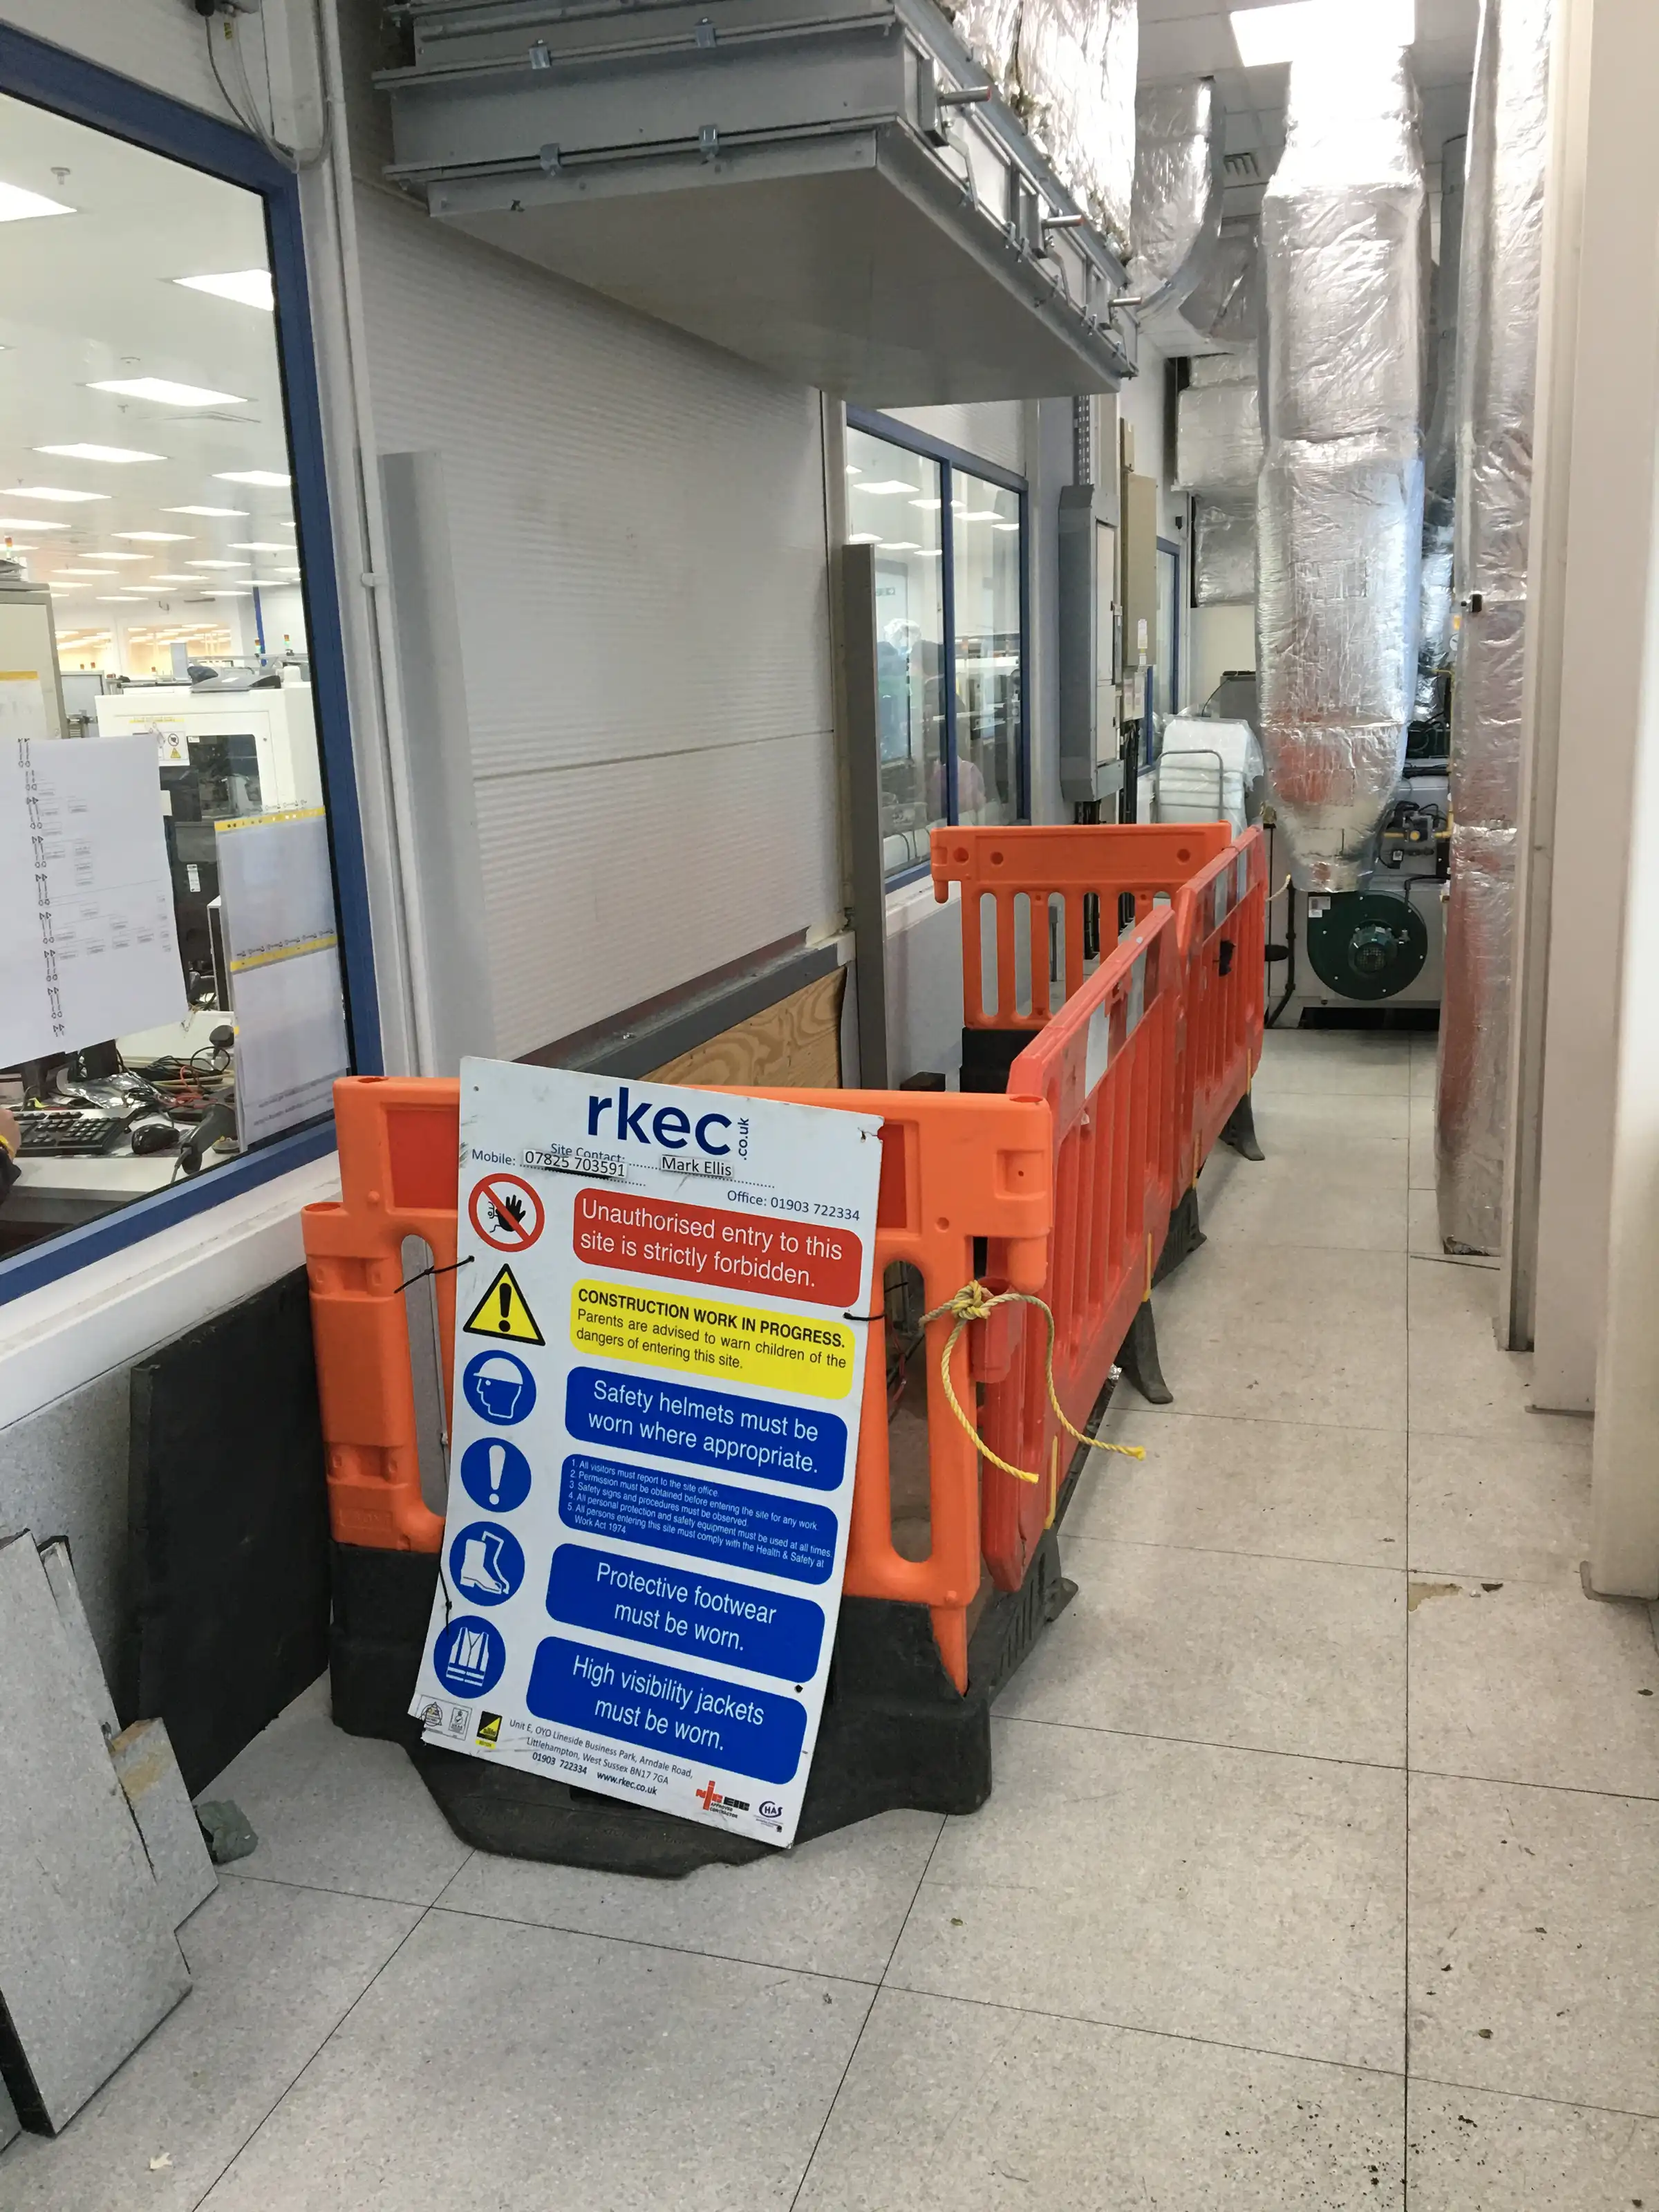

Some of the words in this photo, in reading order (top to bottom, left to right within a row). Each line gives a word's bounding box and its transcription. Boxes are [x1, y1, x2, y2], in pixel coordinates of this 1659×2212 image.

[588, 1086, 732, 1156] rkec
[737, 1117, 749, 1161] .co.uk
[472, 1148, 516, 1166] Mobile:
[525, 1150, 570, 1168] 07825
[574, 1156, 625, 1177] 703591
[551, 1143, 573, 1156] Site
[662, 1156, 700, 1173] Mark
[704, 1161, 732, 1176] Ellis
[582, 1197, 715, 1239] Unauthorised
[721, 1226, 774, 1253] entry
[779, 1231, 798, 1253] to
[805, 1235, 842, 1260] this
[727, 1190, 767, 1206] Office:
[770, 1197, 809, 1212] 01903
[813, 1203, 860, 1221] 722334
[580, 1230, 615, 1253] site
[621, 1235, 637, 1257] is
[643, 1241, 707, 1273] strictly
[713, 1250, 814, 1287] forbidden.
[577, 1307, 624, 1328] Parents
[628, 1320, 648, 1332] are
[652, 1324, 700, 1341] advised
[704, 1331, 715, 1344] to
[720, 1336, 750, 1351] warn
[755, 1340, 805, 1360] children
[809, 1351, 822, 1364] of
[826, 1353, 846, 1368] the
[578, 1288, 689, 1320] CONSTRUCTION
[693, 1308, 738, 1329] WORK
[741, 1316, 756, 1332] IN
[760, 1320, 845, 1348] PROGRESS.
[576, 1327, 624, 1347] dangers
[627, 1336, 639, 1349] of
[641, 1341, 690, 1362] entering
[693, 1348, 715, 1363] this
[718, 1353, 742, 1369] site.
[593, 1379, 653, 1412] Safety
[659, 1391, 733, 1425] helmets
[740, 1412, 788, 1436] must
[794, 1418, 818, 1441] be
[588, 1412, 632, 1435] worn
[639, 1421, 697, 1447] where
[702, 1436, 817, 1473] appropriate.
[577, 1481, 601, 1496] Safety
[601, 1488, 621, 1499] signs
[622, 1492, 637, 1502] and
[637, 1496, 679, 1512] procedures
[680, 1506, 700, 1516] must
[700, 1508, 711, 1519] be
[578, 1470, 618, 1486] Permission
[619, 1481, 638, 1491] must
[639, 1483, 649, 1493] be
[650, 1487, 682, 1501] obtained
[684, 1493, 708, 1506] before
[709, 1500, 740, 1515] entering
[741, 1506, 753, 1517] the
[754, 1510, 769, 1519] site
[770, 1511, 781, 1522] for
[782, 1516, 797, 1527] any
[579, 1460, 588, 1469] All
[590, 1464, 616, 1475] visitors
[617, 1469, 635, 1479] must
[636, 1473, 659, 1484] report
[660, 1477, 668, 1486] to
[669, 1479, 682, 1489] the
[682, 1483, 696, 1492] site
[574, 1514, 593, 1526] Work
[594, 1519, 606, 1530] Act
[574, 1503, 585, 1512] All
[585, 1507, 615, 1520] persons
[616, 1514, 646, 1529] entering
[648, 1519, 661, 1530] this
[662, 1524, 675, 1534] site
[677, 1528, 695, 1538] must
[696, 1532, 724, 1546] comply
[724, 1538, 740, 1548] with
[742, 1541, 754, 1552] the
[756, 1544, 780, 1557] Health
[782, 1550, 788, 1559] &
[789, 1551, 815, 1567] Safety
[816, 1559, 824, 1568] at
[576, 1492, 585, 1501] All
[587, 1497, 619, 1509] personal
[619, 1503, 655, 1517] protection
[657, 1512, 672, 1521] and
[673, 1515, 695, 1528] safety
[697, 1520, 737, 1536] equipment
[737, 1529, 756, 1541] must
[757, 1533, 768, 1543] be
[769, 1537, 788, 1547] used
[789, 1541, 798, 1550] at
[798, 1543, 809, 1552] all
[597, 1562, 688, 1602] Protective
[694, 1585, 777, 1624] footwear
[614, 1603, 660, 1629] must
[664, 1614, 688, 1635] be
[694, 1623, 743, 1651] worn.
[572, 1655, 615, 1687] High
[621, 1671, 693, 1709] visibility
[695, 1687, 764, 1725] jackets
[509, 1718, 525, 1730] Unit
[526, 1723, 533, 1734] E,
[534, 1726, 552, 1737] OYO
[552, 1730, 583, 1747] Lineside
[584, 1739, 617, 1756] Business
[618, 1749, 637, 1763] Park,
[639, 1755, 670, 1771] Arndale
[671, 1764, 693, 1779] Road,
[594, 1699, 641, 1727] must
[644, 1709, 668, 1734] be
[675, 1721, 723, 1750] worn.
[526, 1737, 580, 1760] Littlehampton,
[582, 1752, 602, 1765] West
[602, 1759, 628, 1772] Sussex
[629, 1766, 651, 1779] BN17
[652, 1772, 668, 1785] 7GA
[532, 1752, 556, 1765] 01903
[559, 1759, 587, 1774] 722334
[597, 1771, 657, 1795] www.rkec.co.uk
[758, 1800, 783, 1818] CHAS
